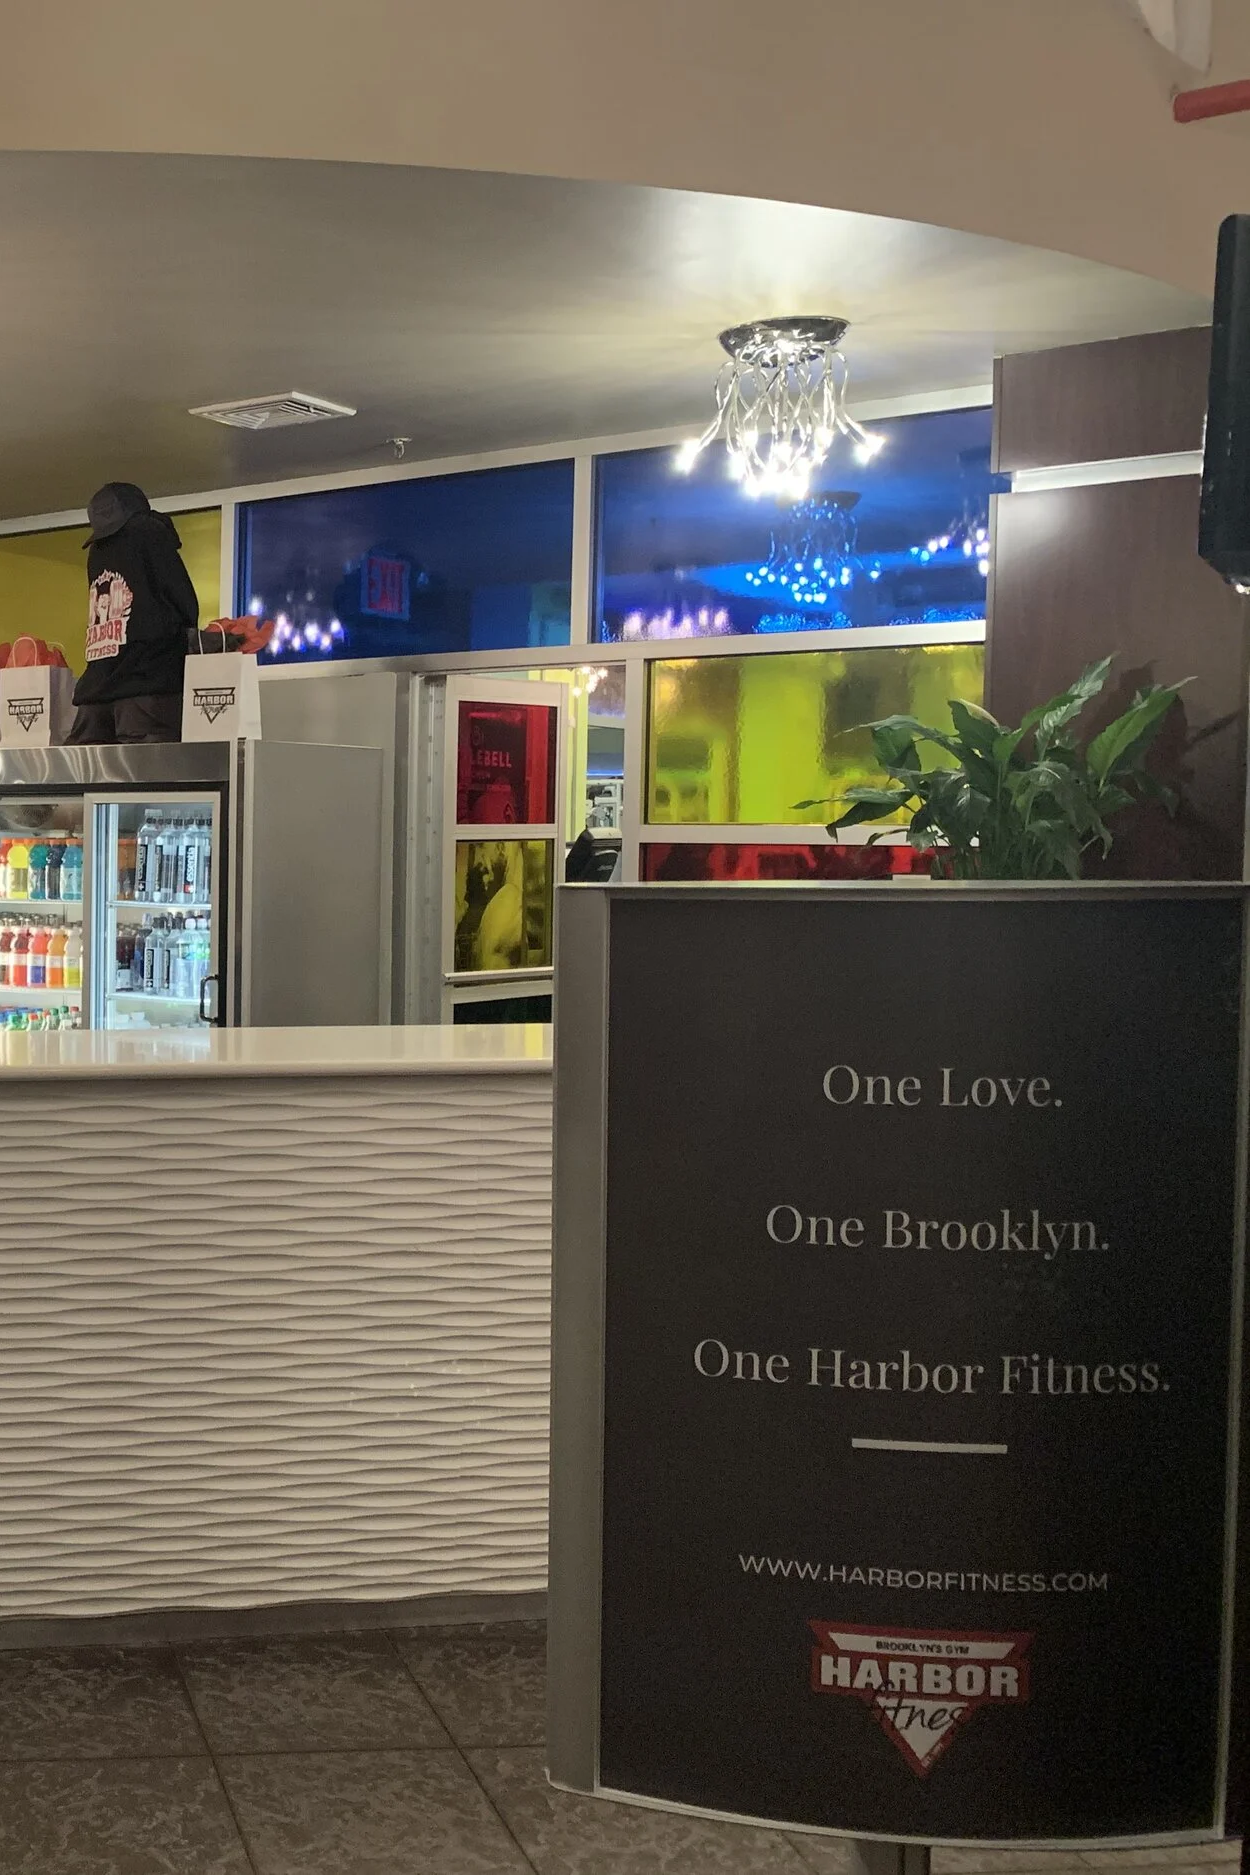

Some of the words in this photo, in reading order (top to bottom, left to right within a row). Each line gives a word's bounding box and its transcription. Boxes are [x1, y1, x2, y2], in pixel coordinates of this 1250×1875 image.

[9, 704, 43, 715] HARBOR
[194, 695, 234, 705] HARBOR
[186, 846, 196, 882] essentia
[821, 1063, 922, 1107] One
[940, 1067, 1064, 1108] Love.
[765, 1204, 865, 1248] One
[883, 1209, 1110, 1260] Brooklyn.
[693, 1338, 790, 1385] One
[807, 1347, 985, 1395] Harbor
[1000, 1354, 1172, 1396] Fitness.
[738, 1553, 1109, 1593] WWW.HARBORFITNESS.COM
[875, 1640, 943, 1655] BROOKLYN'S
[945, 1644, 970, 1656] GYM
[820, 1654, 1020, 1698] HARBOR
